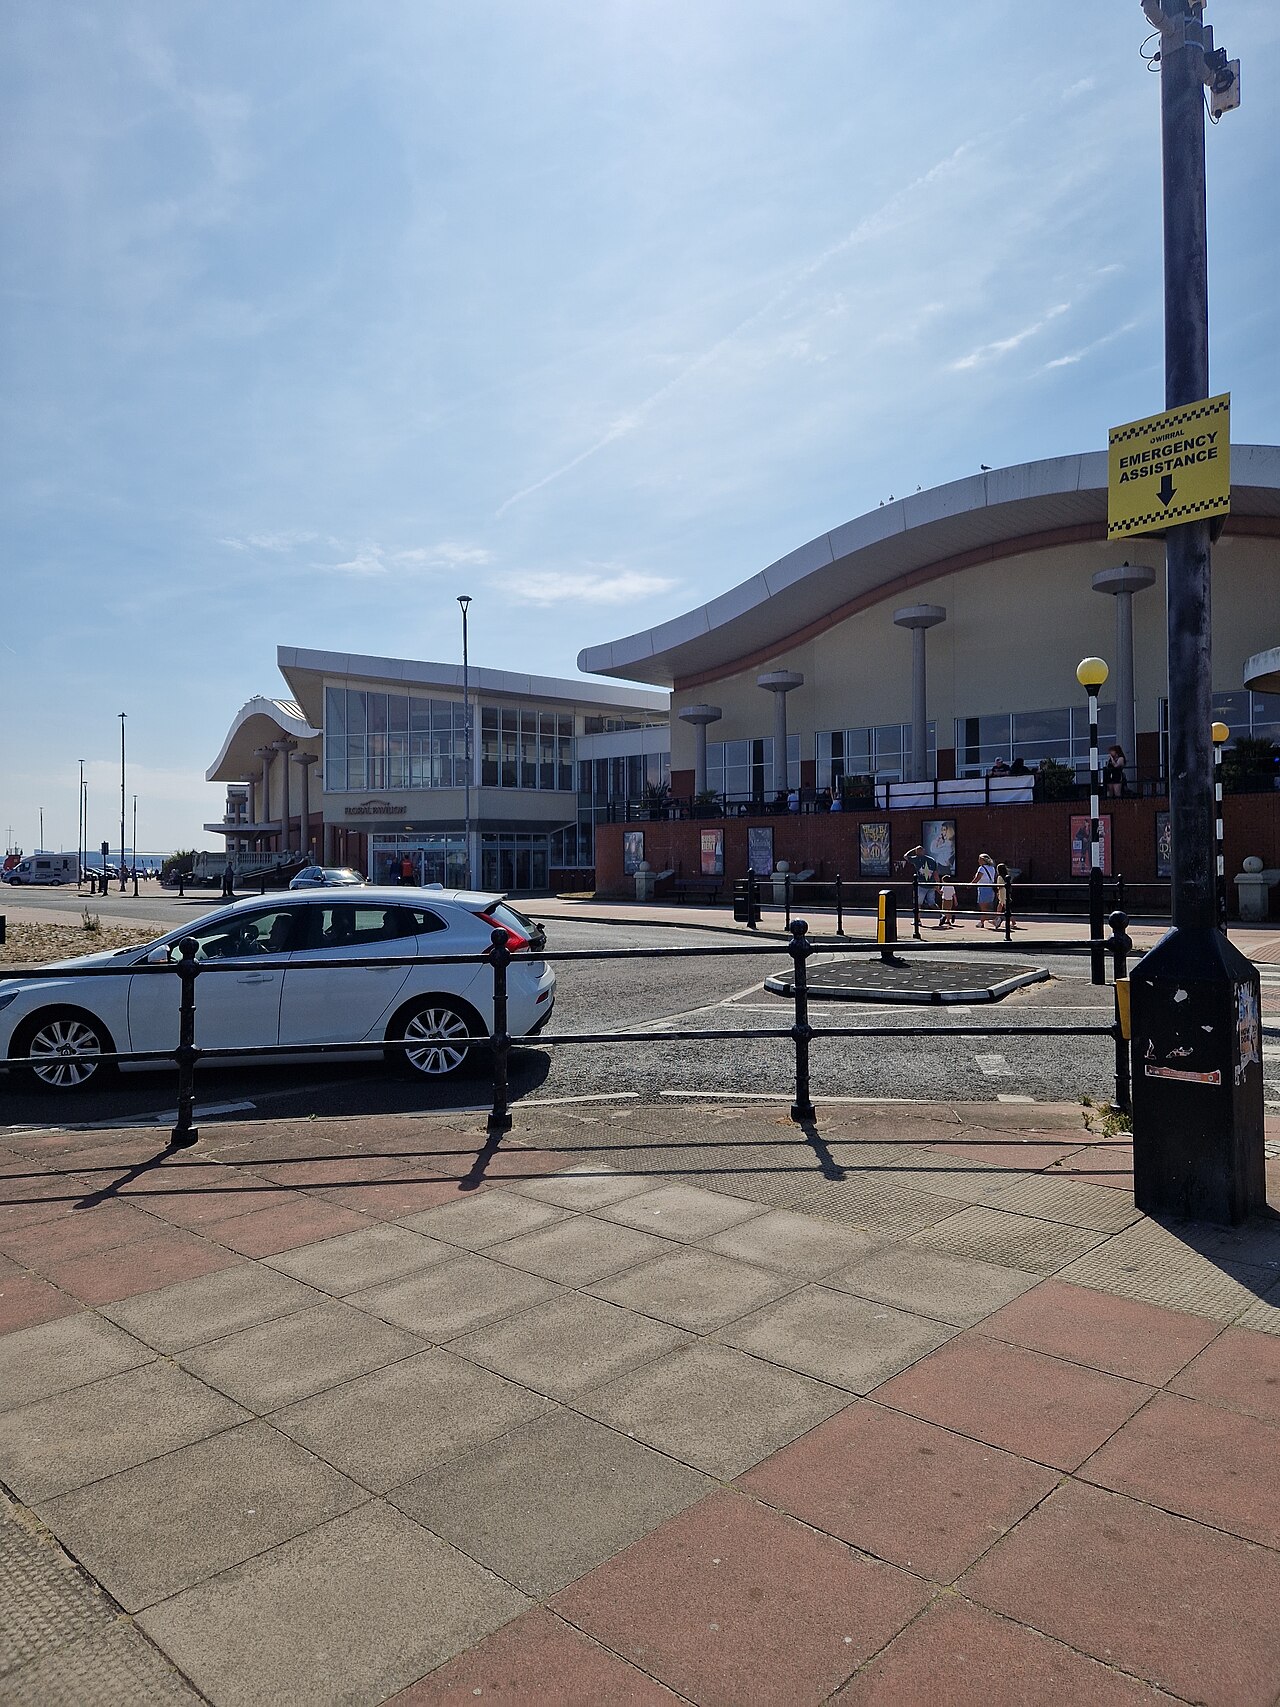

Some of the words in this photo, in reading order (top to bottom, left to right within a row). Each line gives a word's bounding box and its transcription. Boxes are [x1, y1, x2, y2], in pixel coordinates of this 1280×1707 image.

[1156, 430, 1185, 442] WIRRAL
[1119, 431, 1218, 469] EMERGENCY
[1119, 447, 1218, 484] ASSISTANCE
[345, 807, 371, 815] FLORAL
